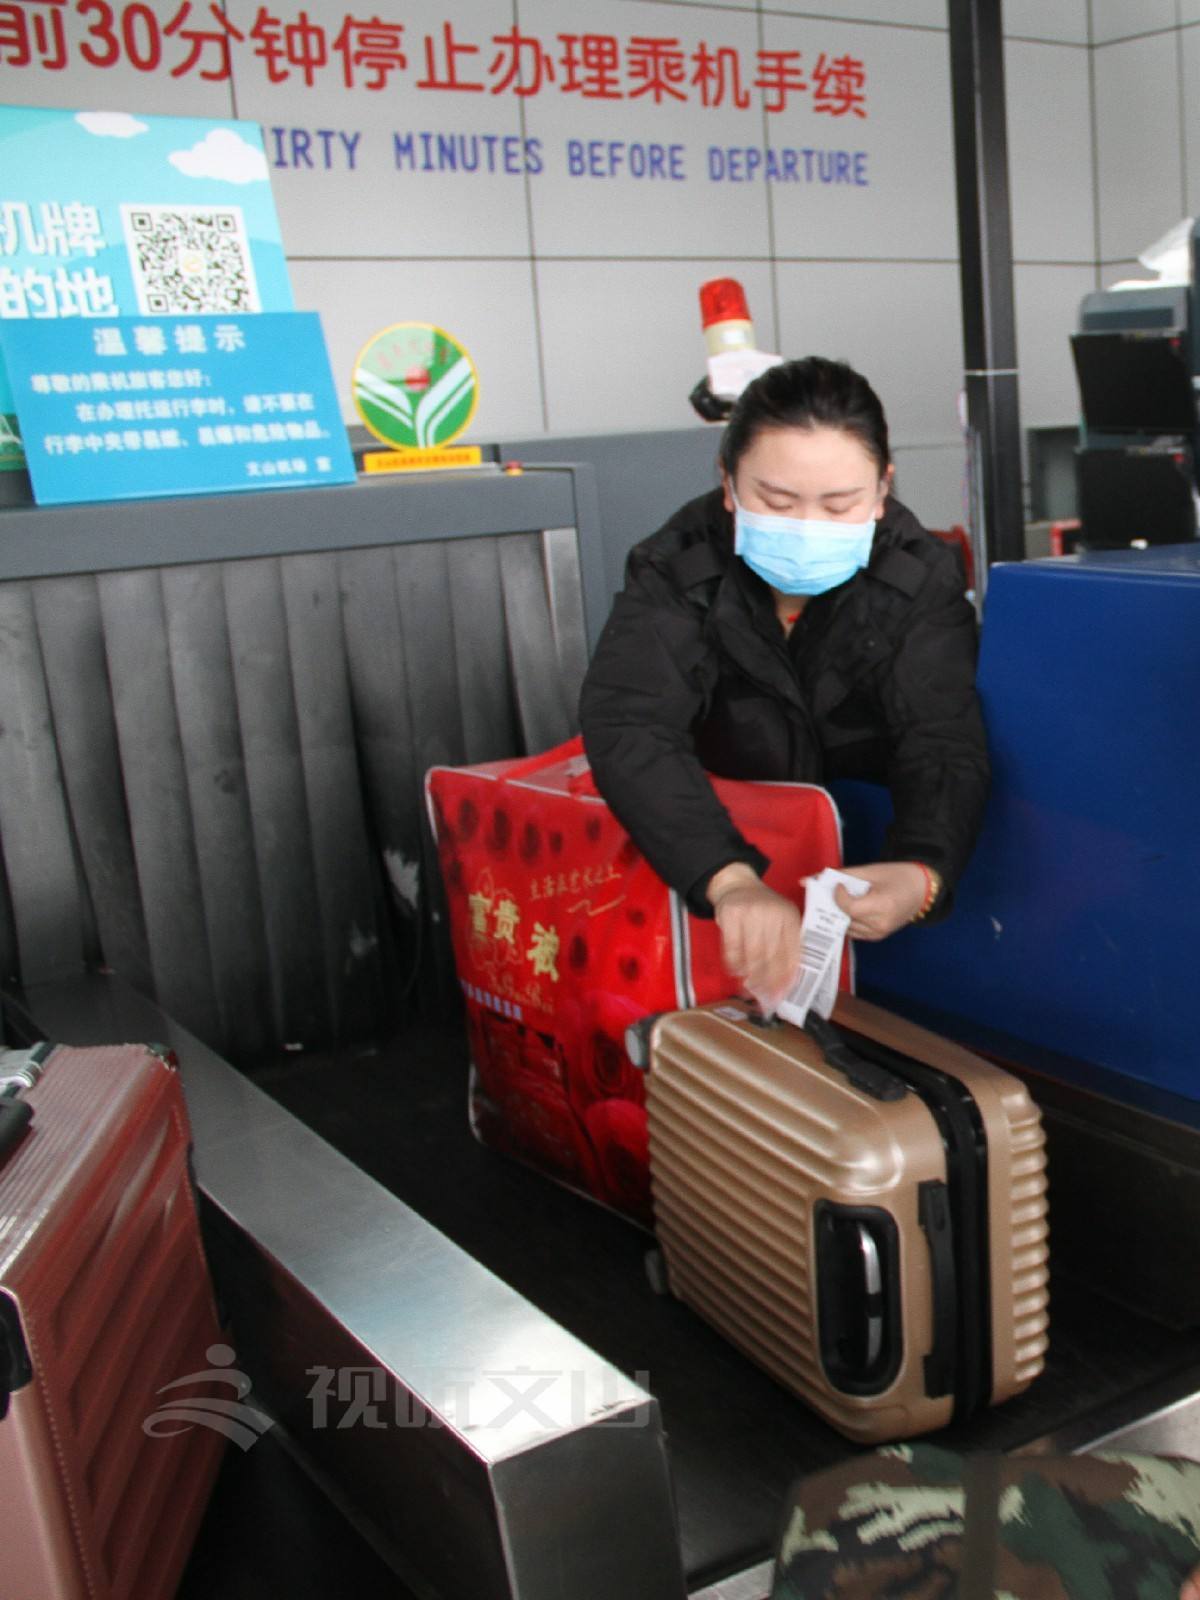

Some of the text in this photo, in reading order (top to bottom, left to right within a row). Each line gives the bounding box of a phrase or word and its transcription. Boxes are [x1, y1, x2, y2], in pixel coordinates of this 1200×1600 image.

[270, 127, 870, 187] IRTY MINUTES BEFORE DEPARTURE
[0, 267, 119, 319] 的地
[93, 324, 246, 357] 温馨提示
